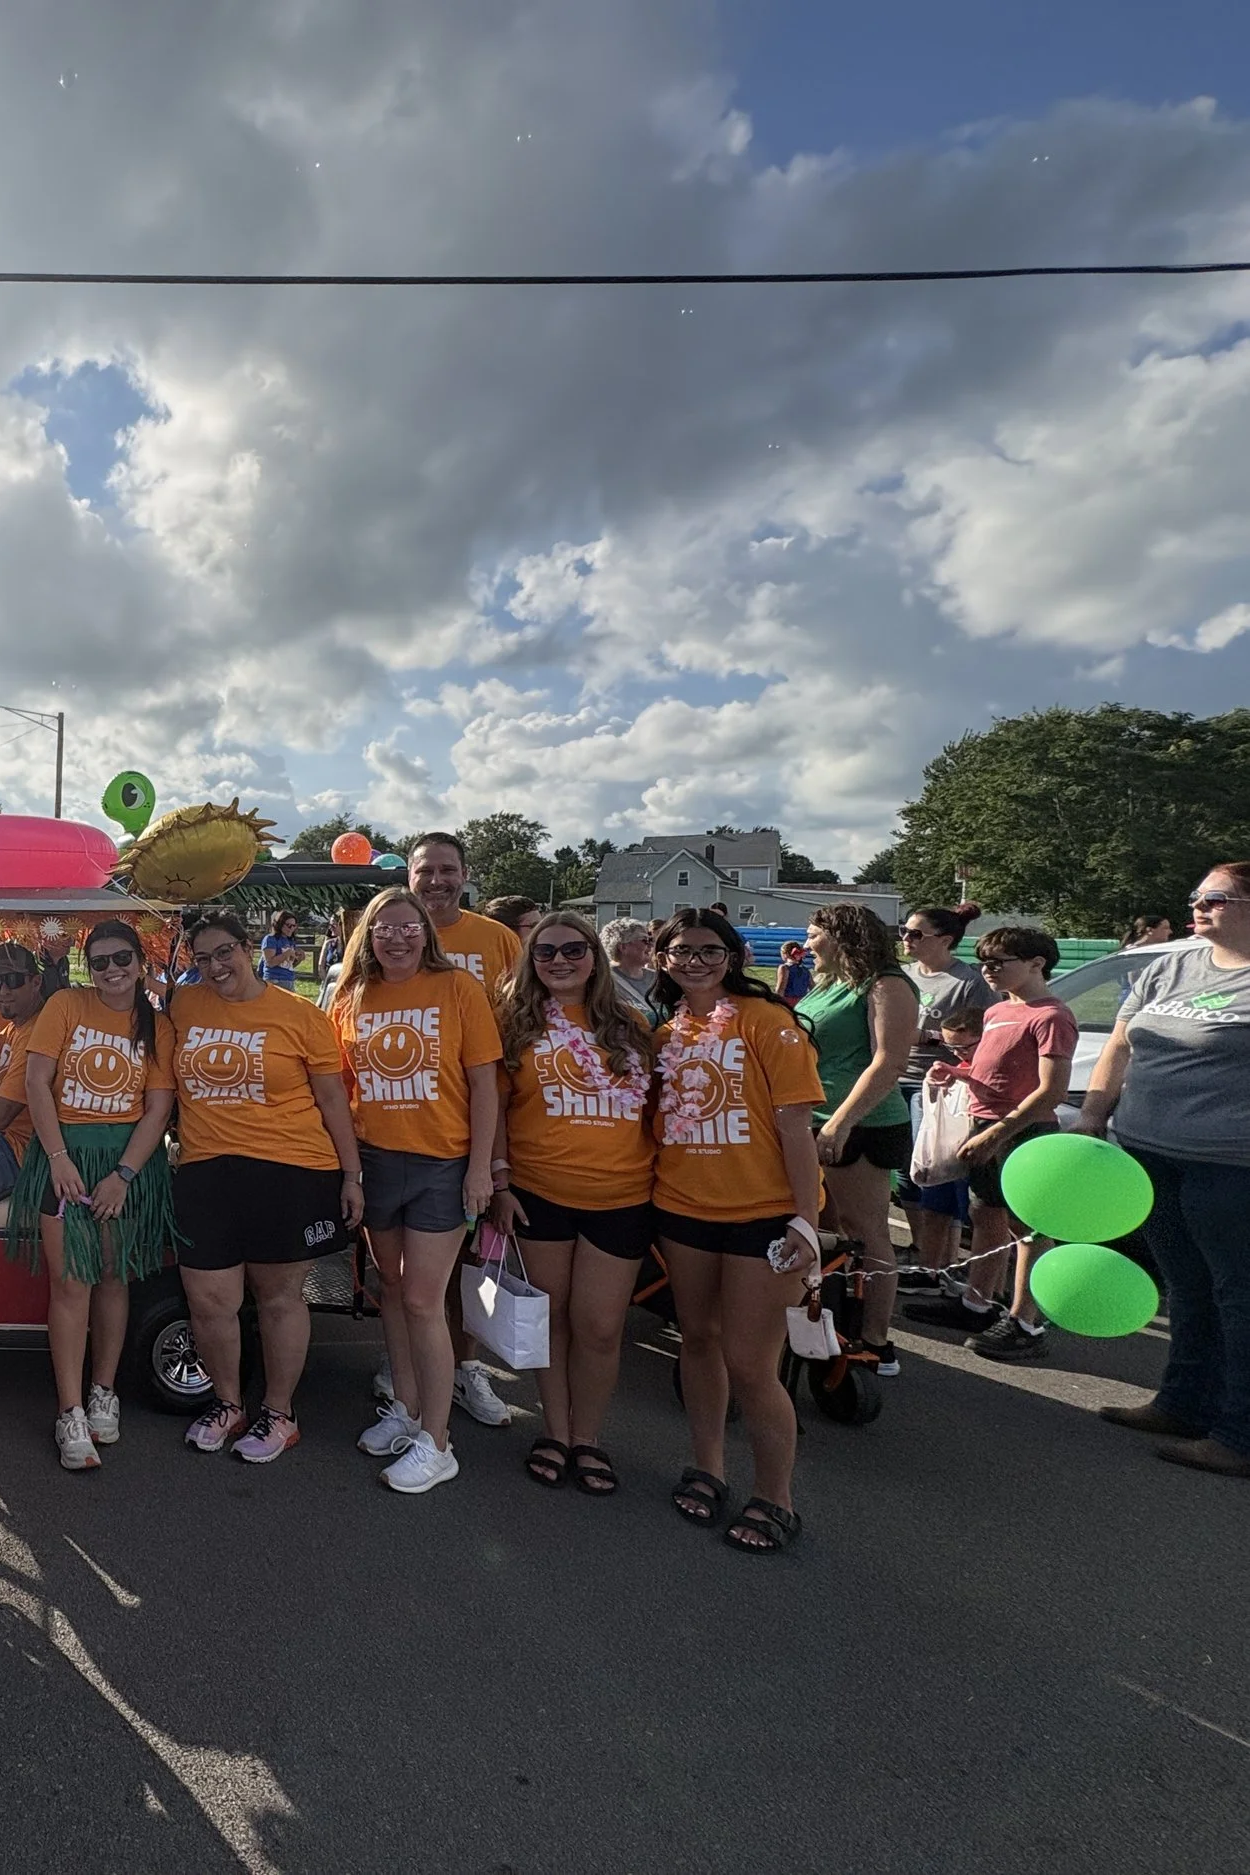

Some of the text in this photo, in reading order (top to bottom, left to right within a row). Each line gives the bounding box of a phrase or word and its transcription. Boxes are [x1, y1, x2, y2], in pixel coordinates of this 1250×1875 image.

[183, 1026, 267, 1053] SHINE
[356, 1007, 440, 1040] SHINE
[69, 1024, 145, 1067] SHINE
[61, 1078, 135, 1114] SHINE
[358, 1070, 440, 1102] SHINE
[304, 1220, 336, 1247] GAP
